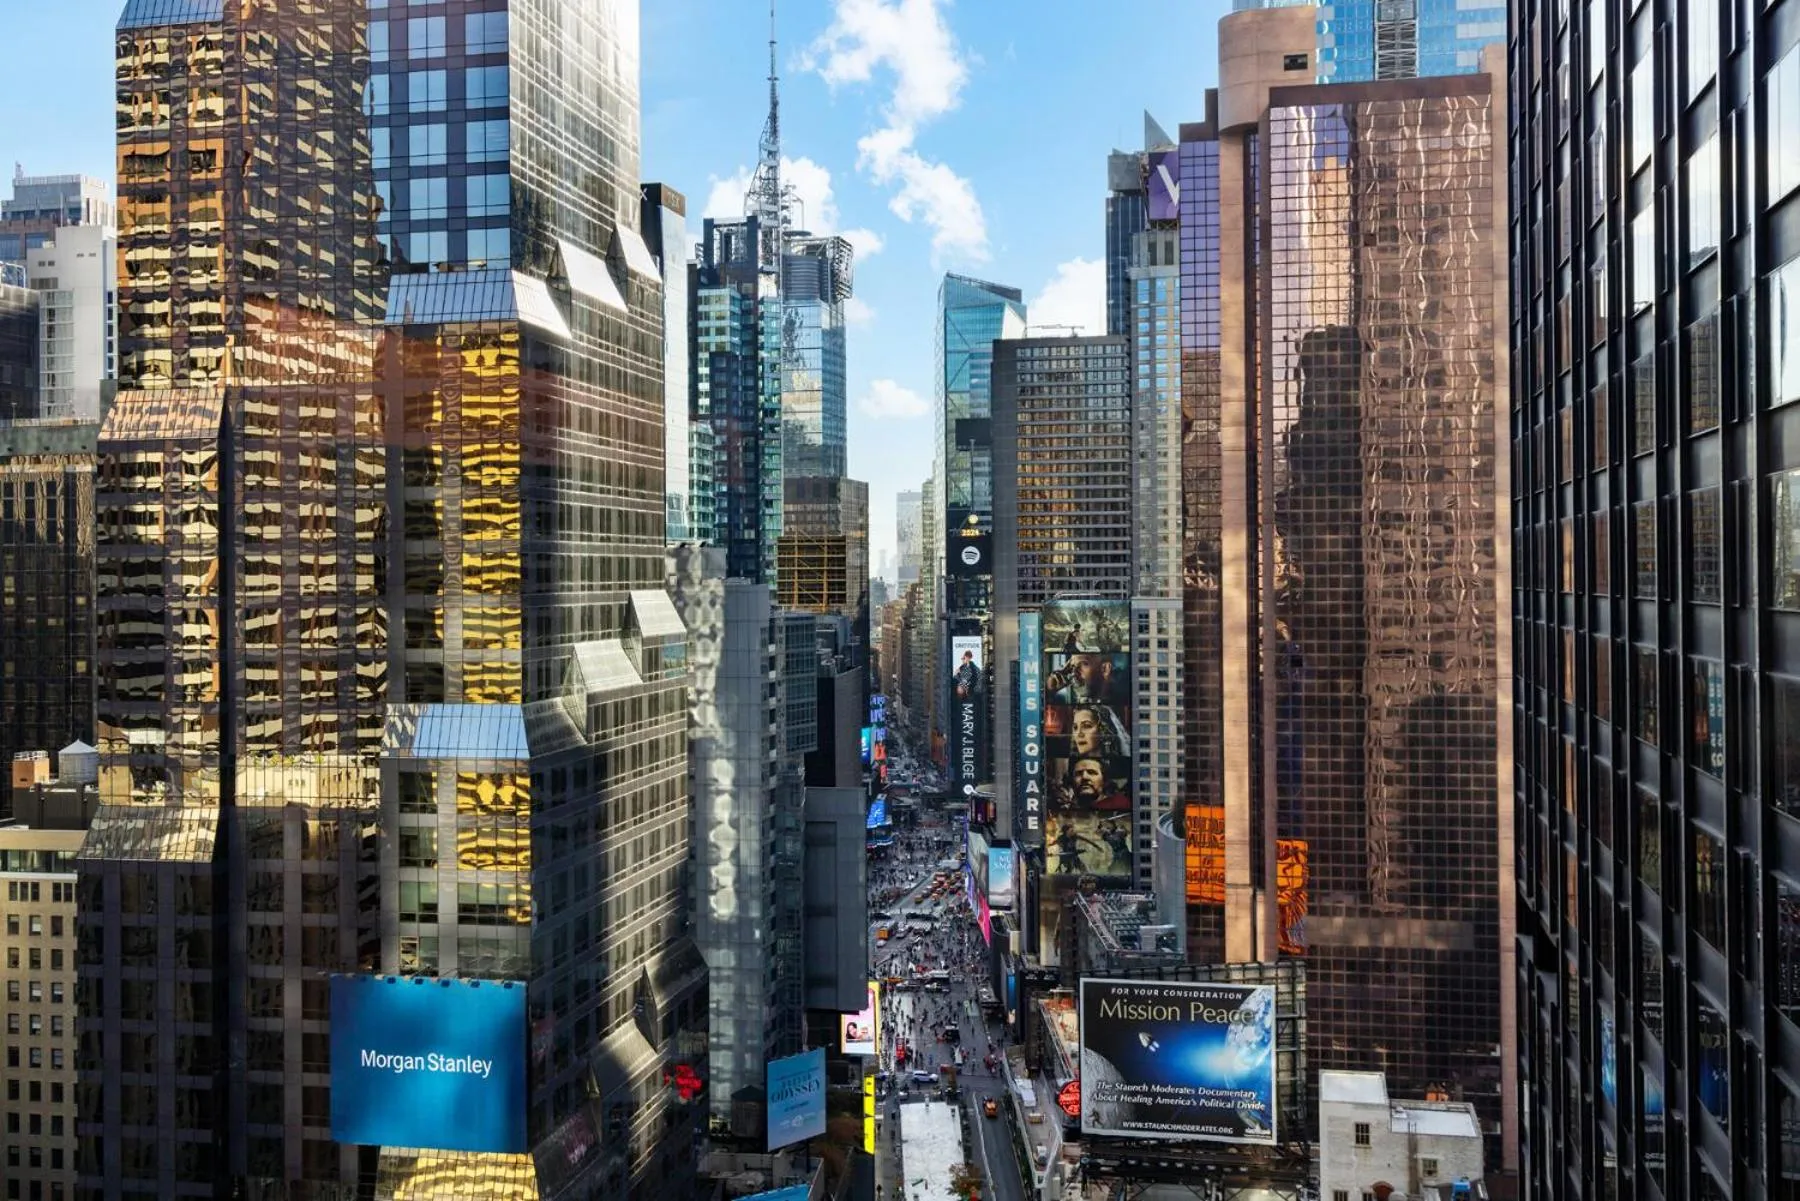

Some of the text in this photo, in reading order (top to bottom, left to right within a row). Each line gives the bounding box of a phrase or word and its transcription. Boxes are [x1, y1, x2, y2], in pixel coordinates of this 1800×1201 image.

[961, 703, 975, 779] MARY J. BLIGE
[1023, 625, 1039, 830] TIMES SQUARE
[1111, 987, 1242, 999] FOR YOUR CONSIDERATION
[1099, 998, 1254, 1025] Mission Peace
[361, 1049, 492, 1079] Morgan Stanley
[1092, 1092, 1266, 1111] About Healing America's Political Divide
[1097, 1081, 1257, 1099] The Staunch Moderates Documentary
